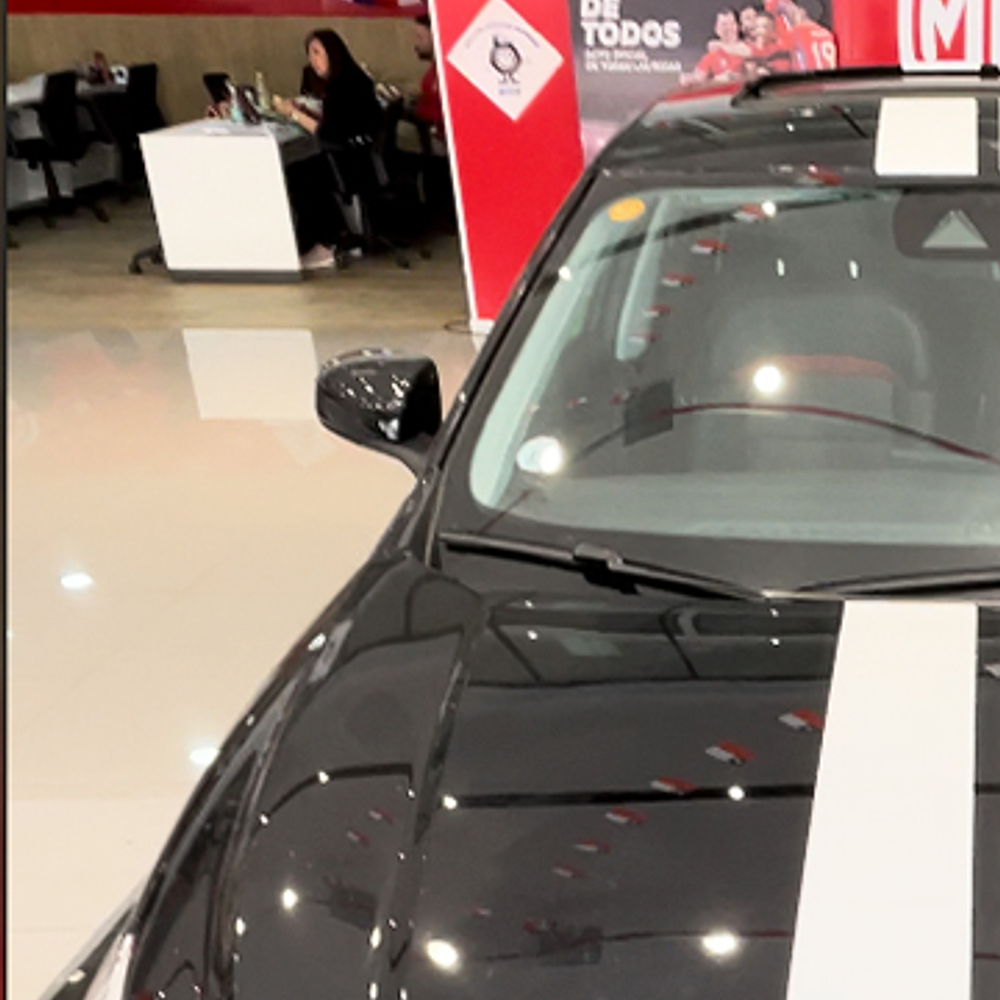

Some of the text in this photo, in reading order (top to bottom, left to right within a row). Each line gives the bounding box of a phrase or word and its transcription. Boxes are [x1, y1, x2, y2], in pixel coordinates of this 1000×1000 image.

[580, 0, 620, 19] DE
[580, 19, 682, 49] TODOS
[811, 41, 837, 70] 19
